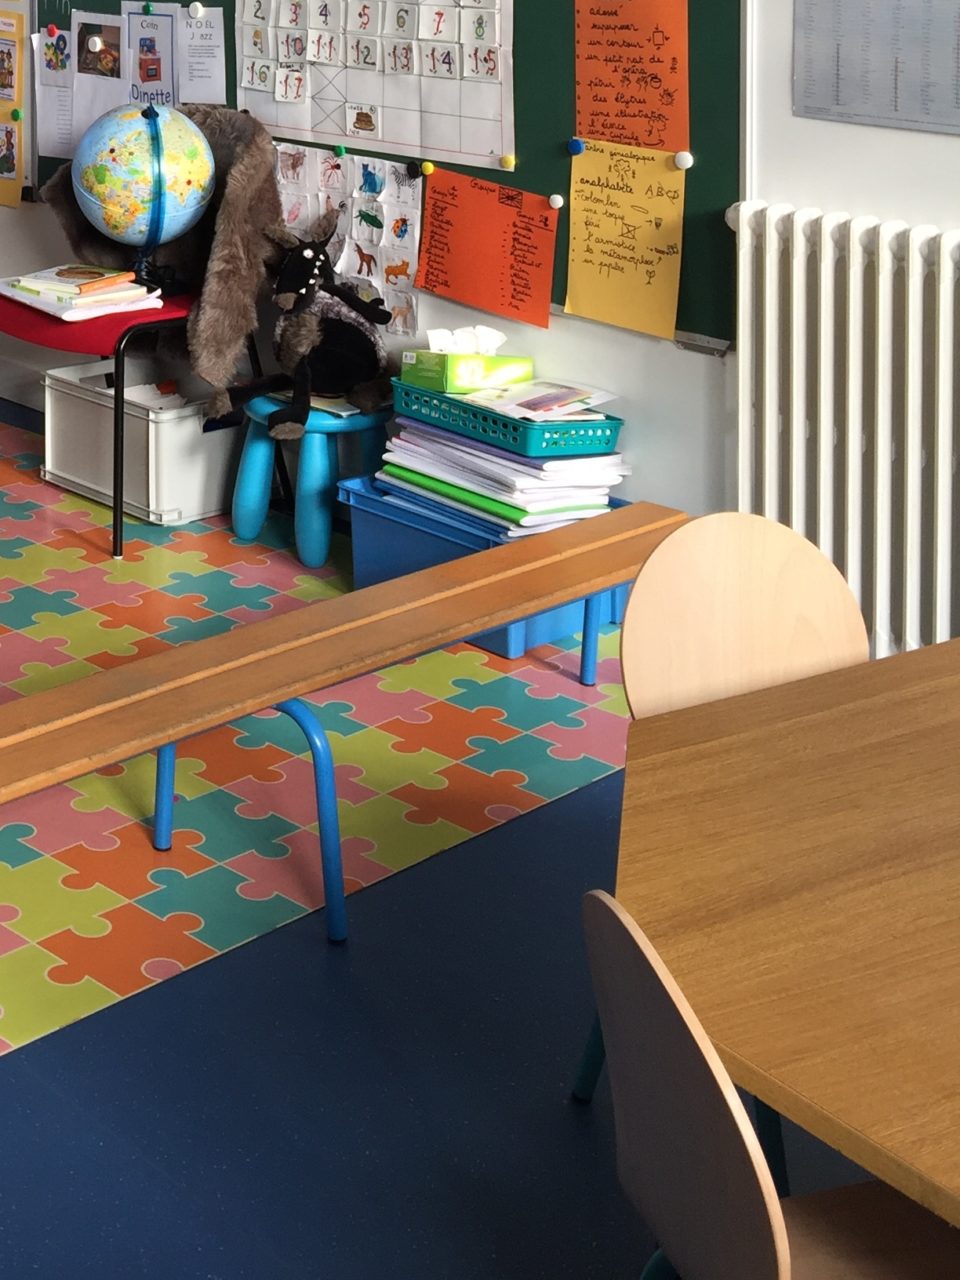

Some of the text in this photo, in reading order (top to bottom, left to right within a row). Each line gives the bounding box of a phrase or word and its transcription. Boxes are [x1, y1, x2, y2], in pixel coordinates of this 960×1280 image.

[253, 0, 265, 21] 2
[290, 0, 301, 25] 3
[318, 1, 330, 25] 4
[359, 4, 371, 30] 5
[396, 9, 409, 30] 6
[433, 10, 445, 36] 7
[140, 19, 159, 31] Coin
[284, 35, 306, 61] 10
[353, 39, 377, 67] 12
[390, 40, 411, 70] 13
[607, 37, 645, 49] contour
[428, 47, 453, 74] 14
[470, 45, 496, 75] 15
[603, 53, 624, 67] petit
[627, 56, 644, 65] rat
[649, 54, 665, 65] de
[248, 61, 271, 86] 16
[281, 70, 304, 100] 17
[579, 177, 635, 194] analphabète
